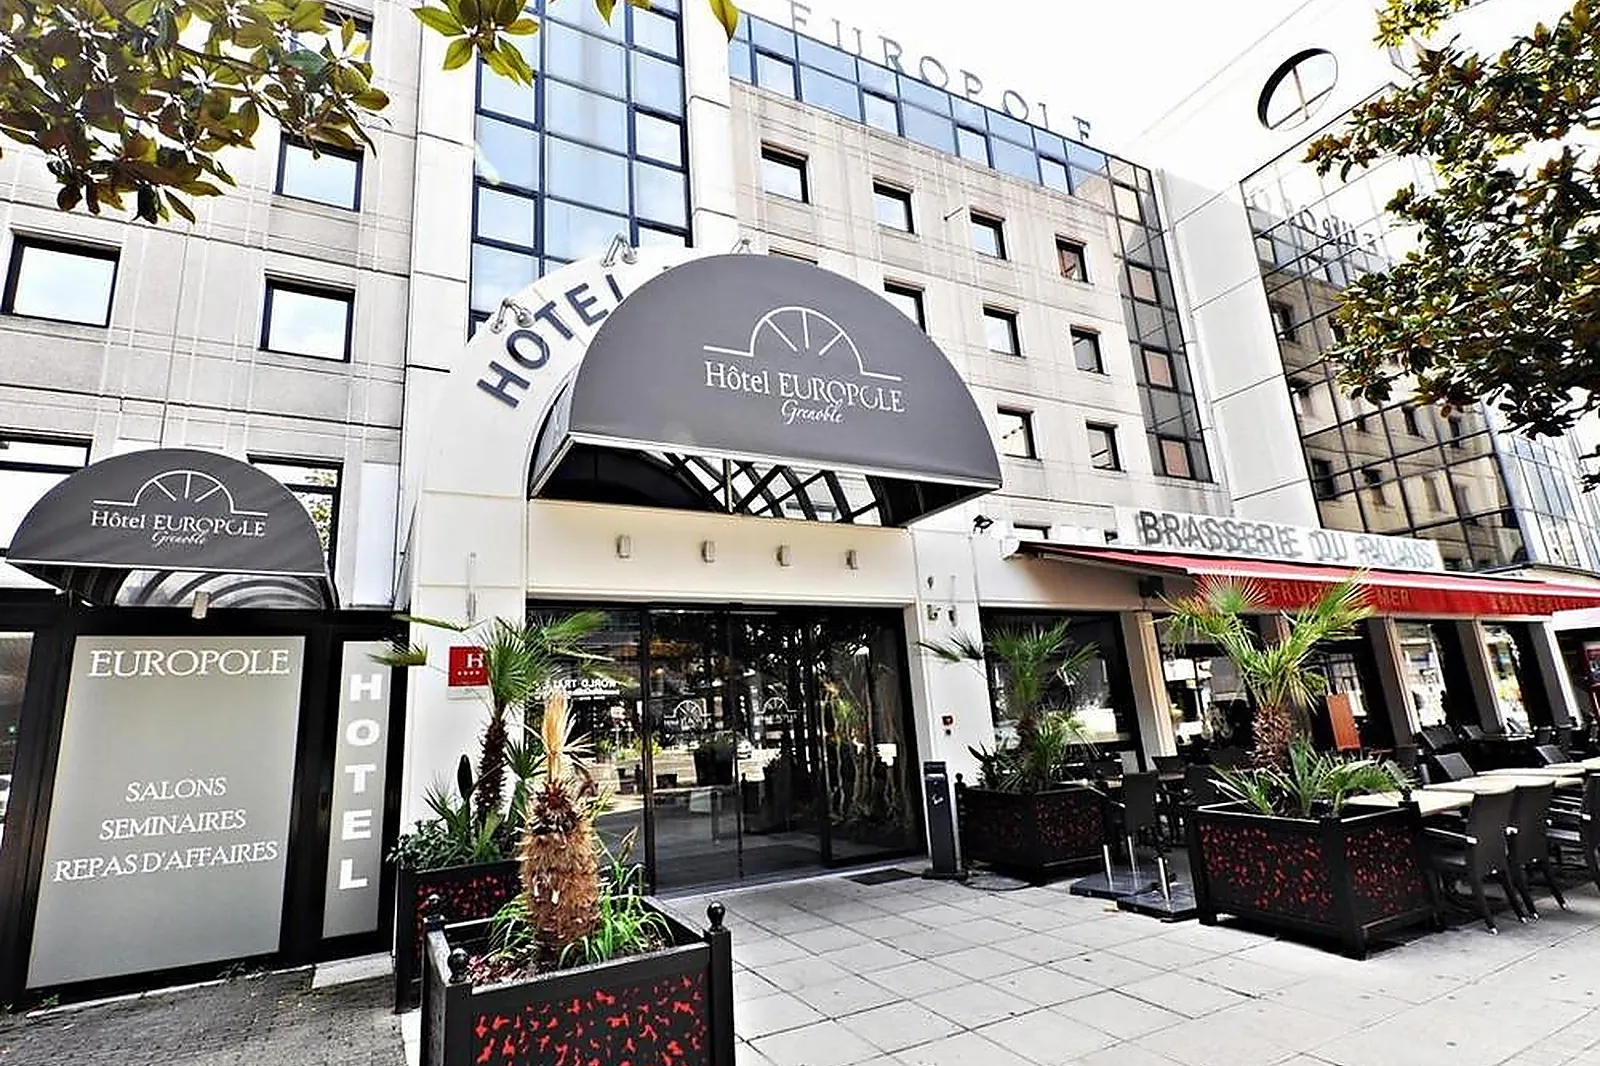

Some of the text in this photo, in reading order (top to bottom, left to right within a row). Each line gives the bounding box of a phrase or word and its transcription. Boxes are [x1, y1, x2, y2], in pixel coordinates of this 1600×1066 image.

[704, 361, 905, 412] Hôtel EUROPOLE
[781, 399, 844, 424] Grenoble
[91, 510, 267, 537] Hôtel EUROPOLE
[1137, 510, 1435, 568] BRASSERIE DU PALAIS
[88, 648, 291, 678] EUROPOLE
[125, 776, 228, 802] SALONS
[339, 672, 384, 890] HOTEL
[99, 808, 247, 841] SEMINAIRES
[53, 840, 279, 883] REPAS D'AFFAIRES
